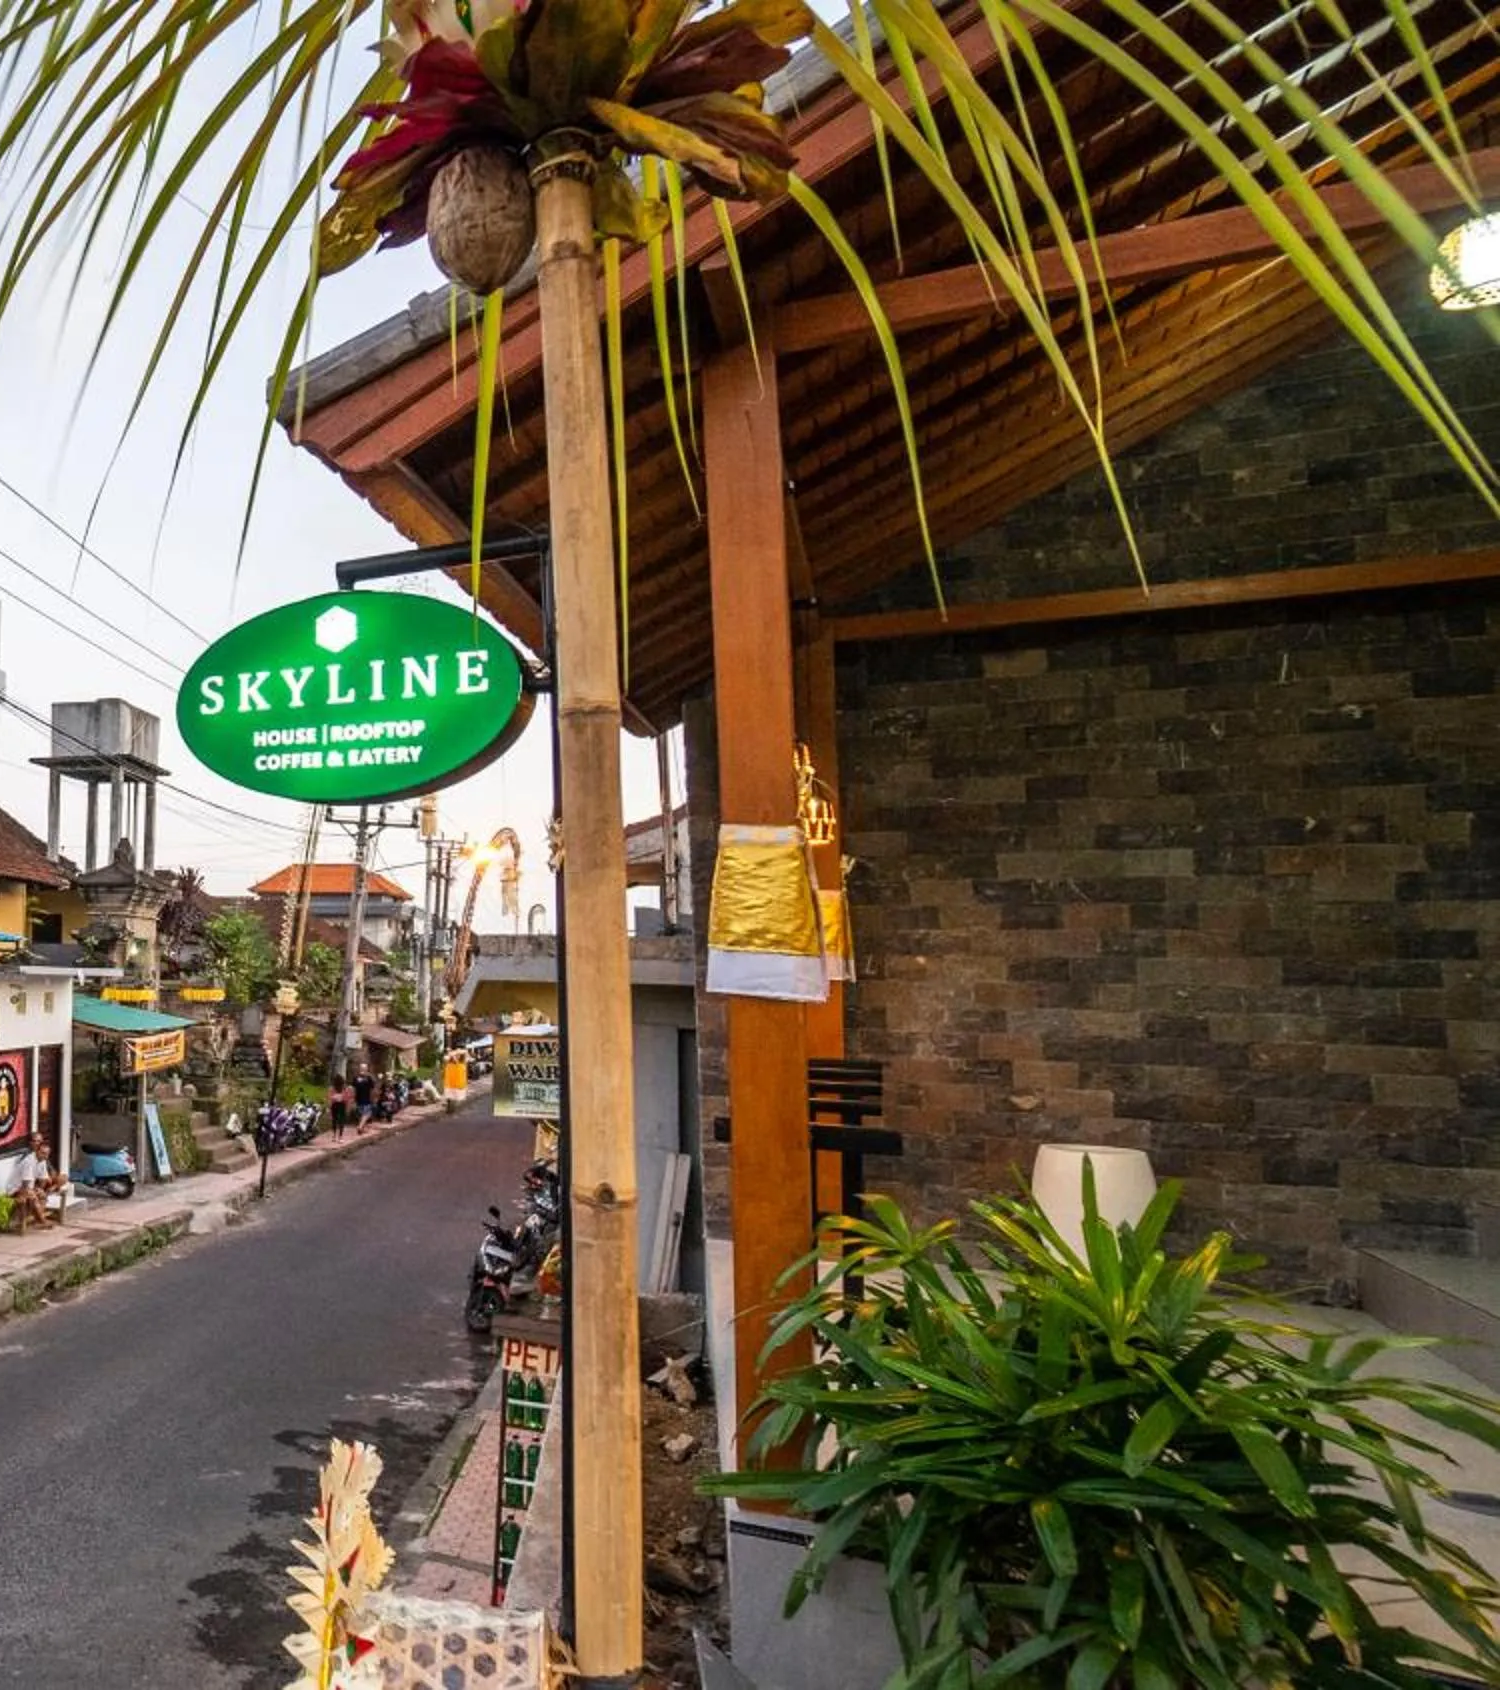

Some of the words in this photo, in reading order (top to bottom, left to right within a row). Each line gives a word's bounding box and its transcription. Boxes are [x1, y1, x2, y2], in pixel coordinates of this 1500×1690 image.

[199, 649, 490, 715] SKYLINE
[253, 725, 318, 748] HOUSE
[330, 719, 426, 743] ROOFTOP
[254, 750, 324, 772] COFFEE
[325, 749, 345, 769] &
[348, 746, 423, 767] EATERY
